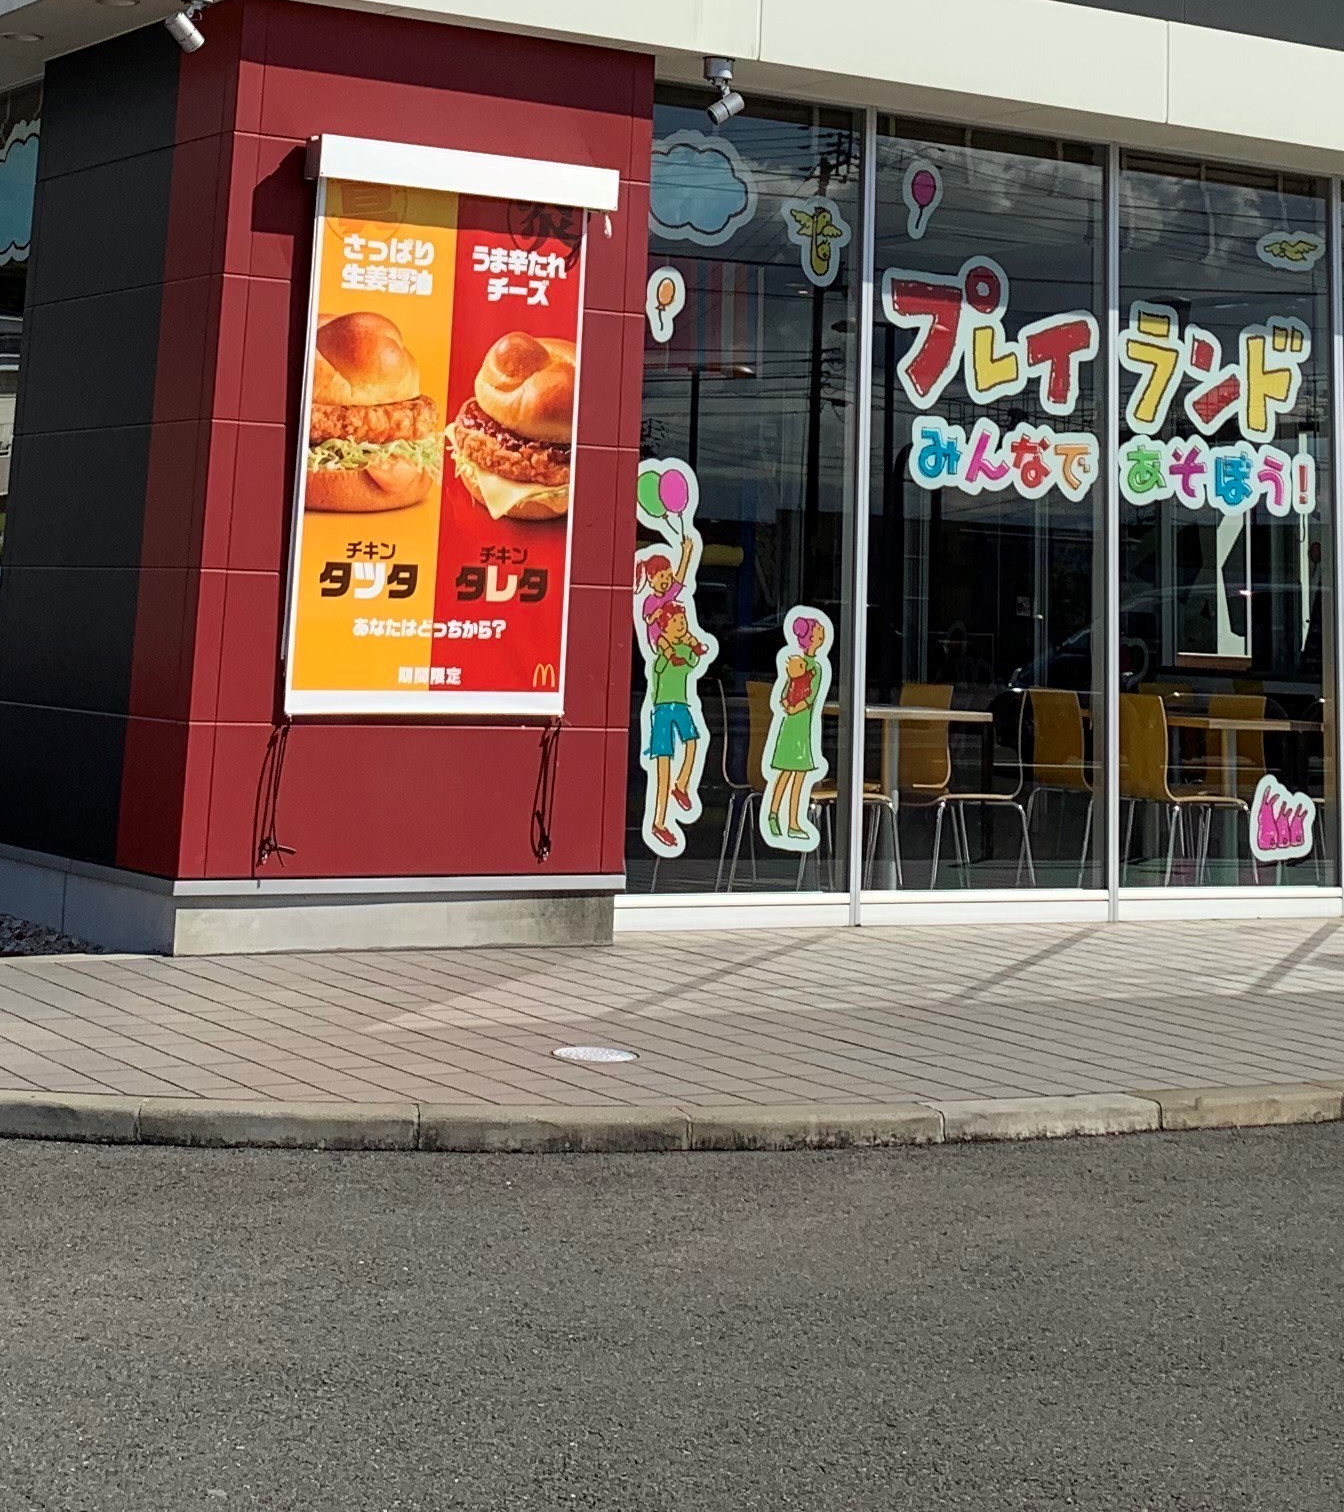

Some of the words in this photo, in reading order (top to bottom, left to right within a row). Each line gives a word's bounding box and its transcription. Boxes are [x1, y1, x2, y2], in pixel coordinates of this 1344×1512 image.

[343, 234, 435, 267] さっぱり
[472, 245, 568, 280] うま辛たれ
[487, 277, 550, 307] チーズ
[346, 541, 396, 560] チキン
[480, 545, 529, 565] チキン
[319, 561, 419, 600] タツタ
[456, 565, 549, 603] タレタ
[352, 618, 507, 639] あなたはどっちから?
[398, 666, 462, 686] 期間限定
